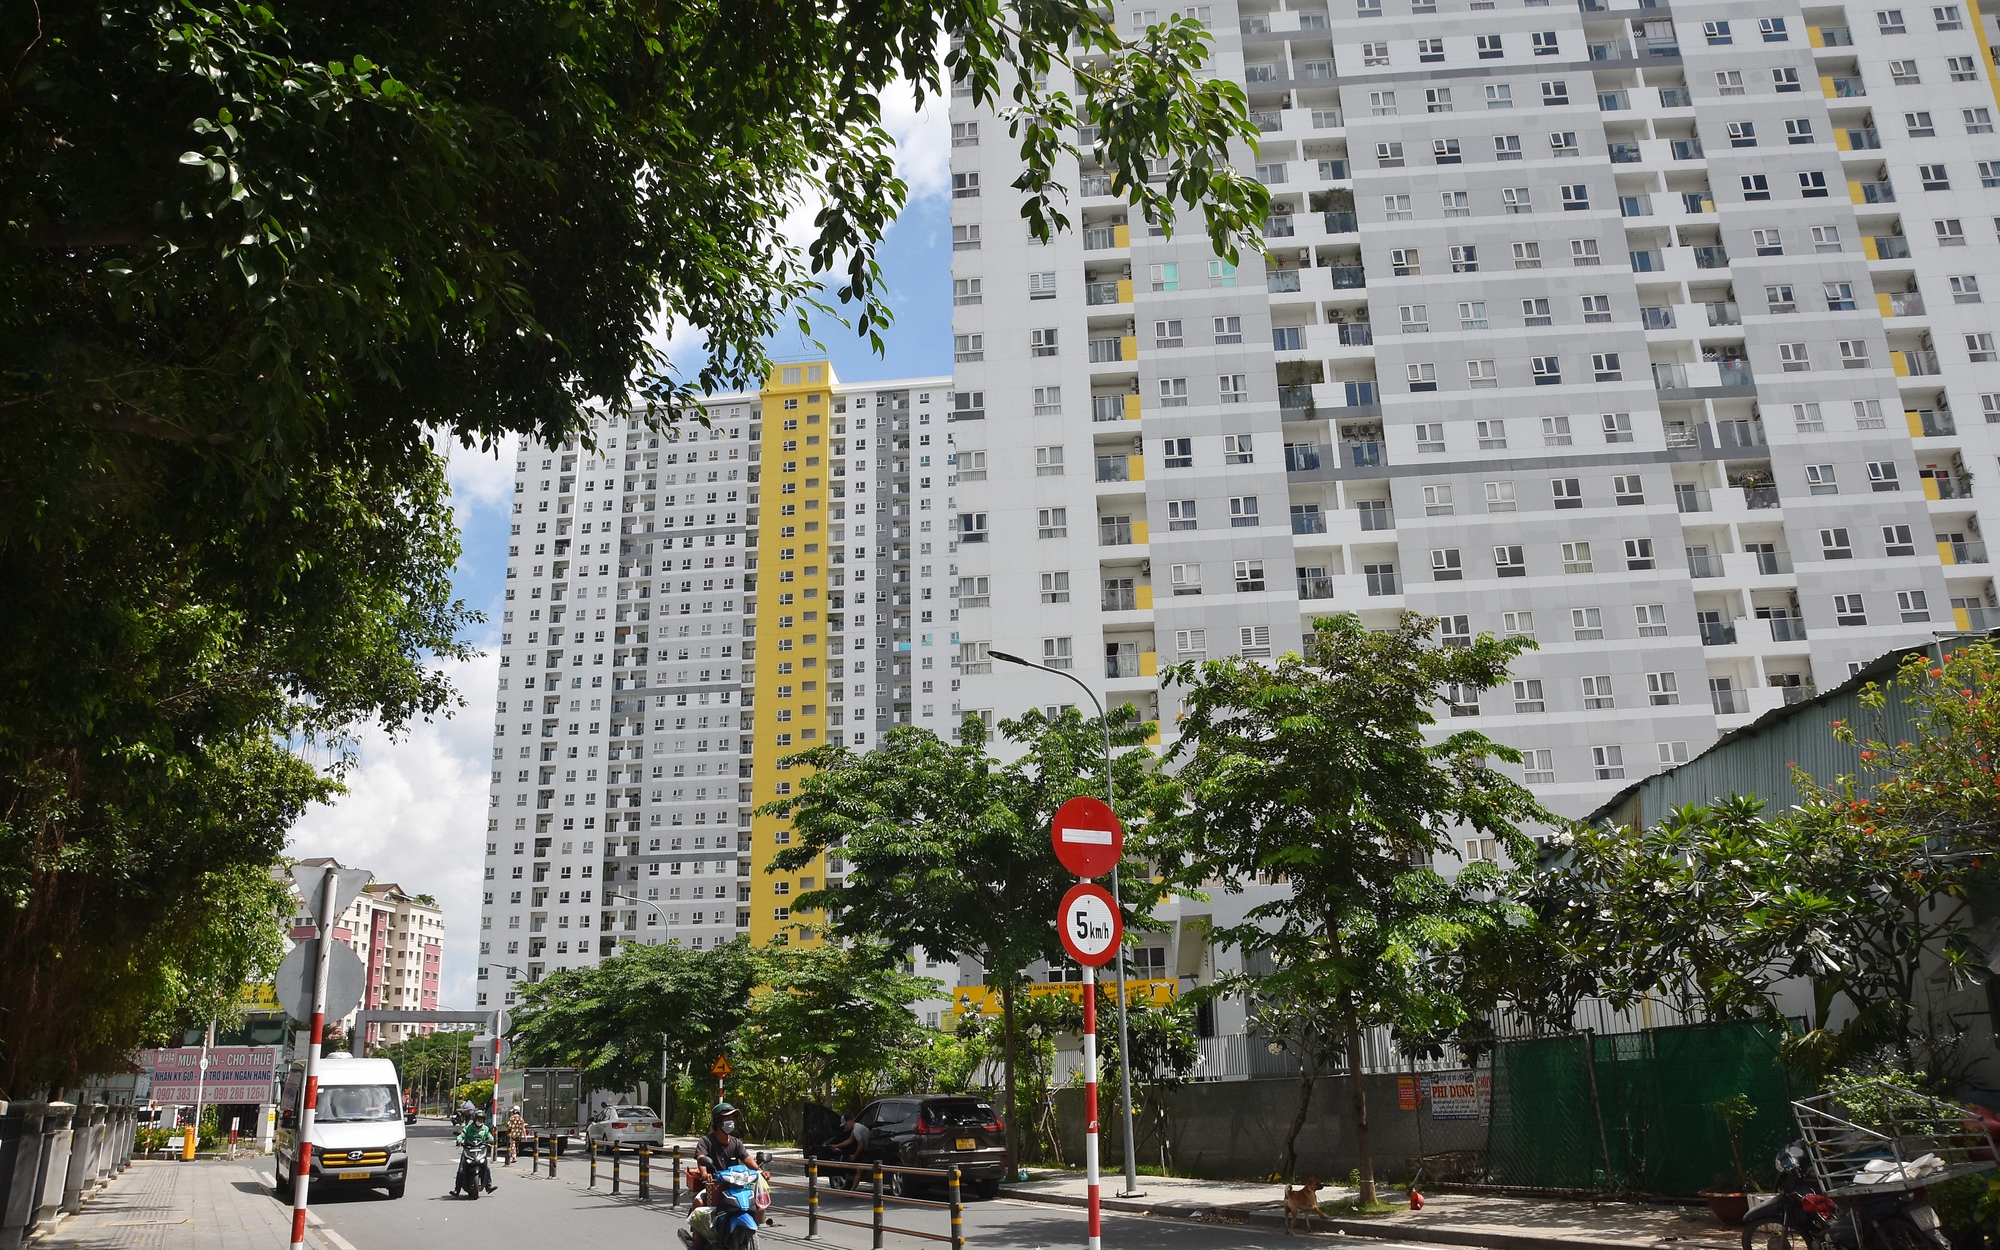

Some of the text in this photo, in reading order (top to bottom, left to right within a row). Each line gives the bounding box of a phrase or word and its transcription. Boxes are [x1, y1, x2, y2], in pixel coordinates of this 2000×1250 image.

[1076, 911, 1109, 939] 5 km/h
[177, 1054, 198, 1067] MUA
[200, 1051, 219, 1067] ÁN
[227, 1053, 246, 1066] CHO
[248, 1050, 272, 1066] THUÊ
[222, 1070, 234, 1081] VAY
[157, 1087, 175, 1100] 0907
[176, 1087, 191, 1100] 383
[214, 1087, 228, 1100] 090
[229, 1087, 244, 1100] 286
[246, 1086, 265, 1099] 1264
[1432, 1086, 1448, 1098] PHI
